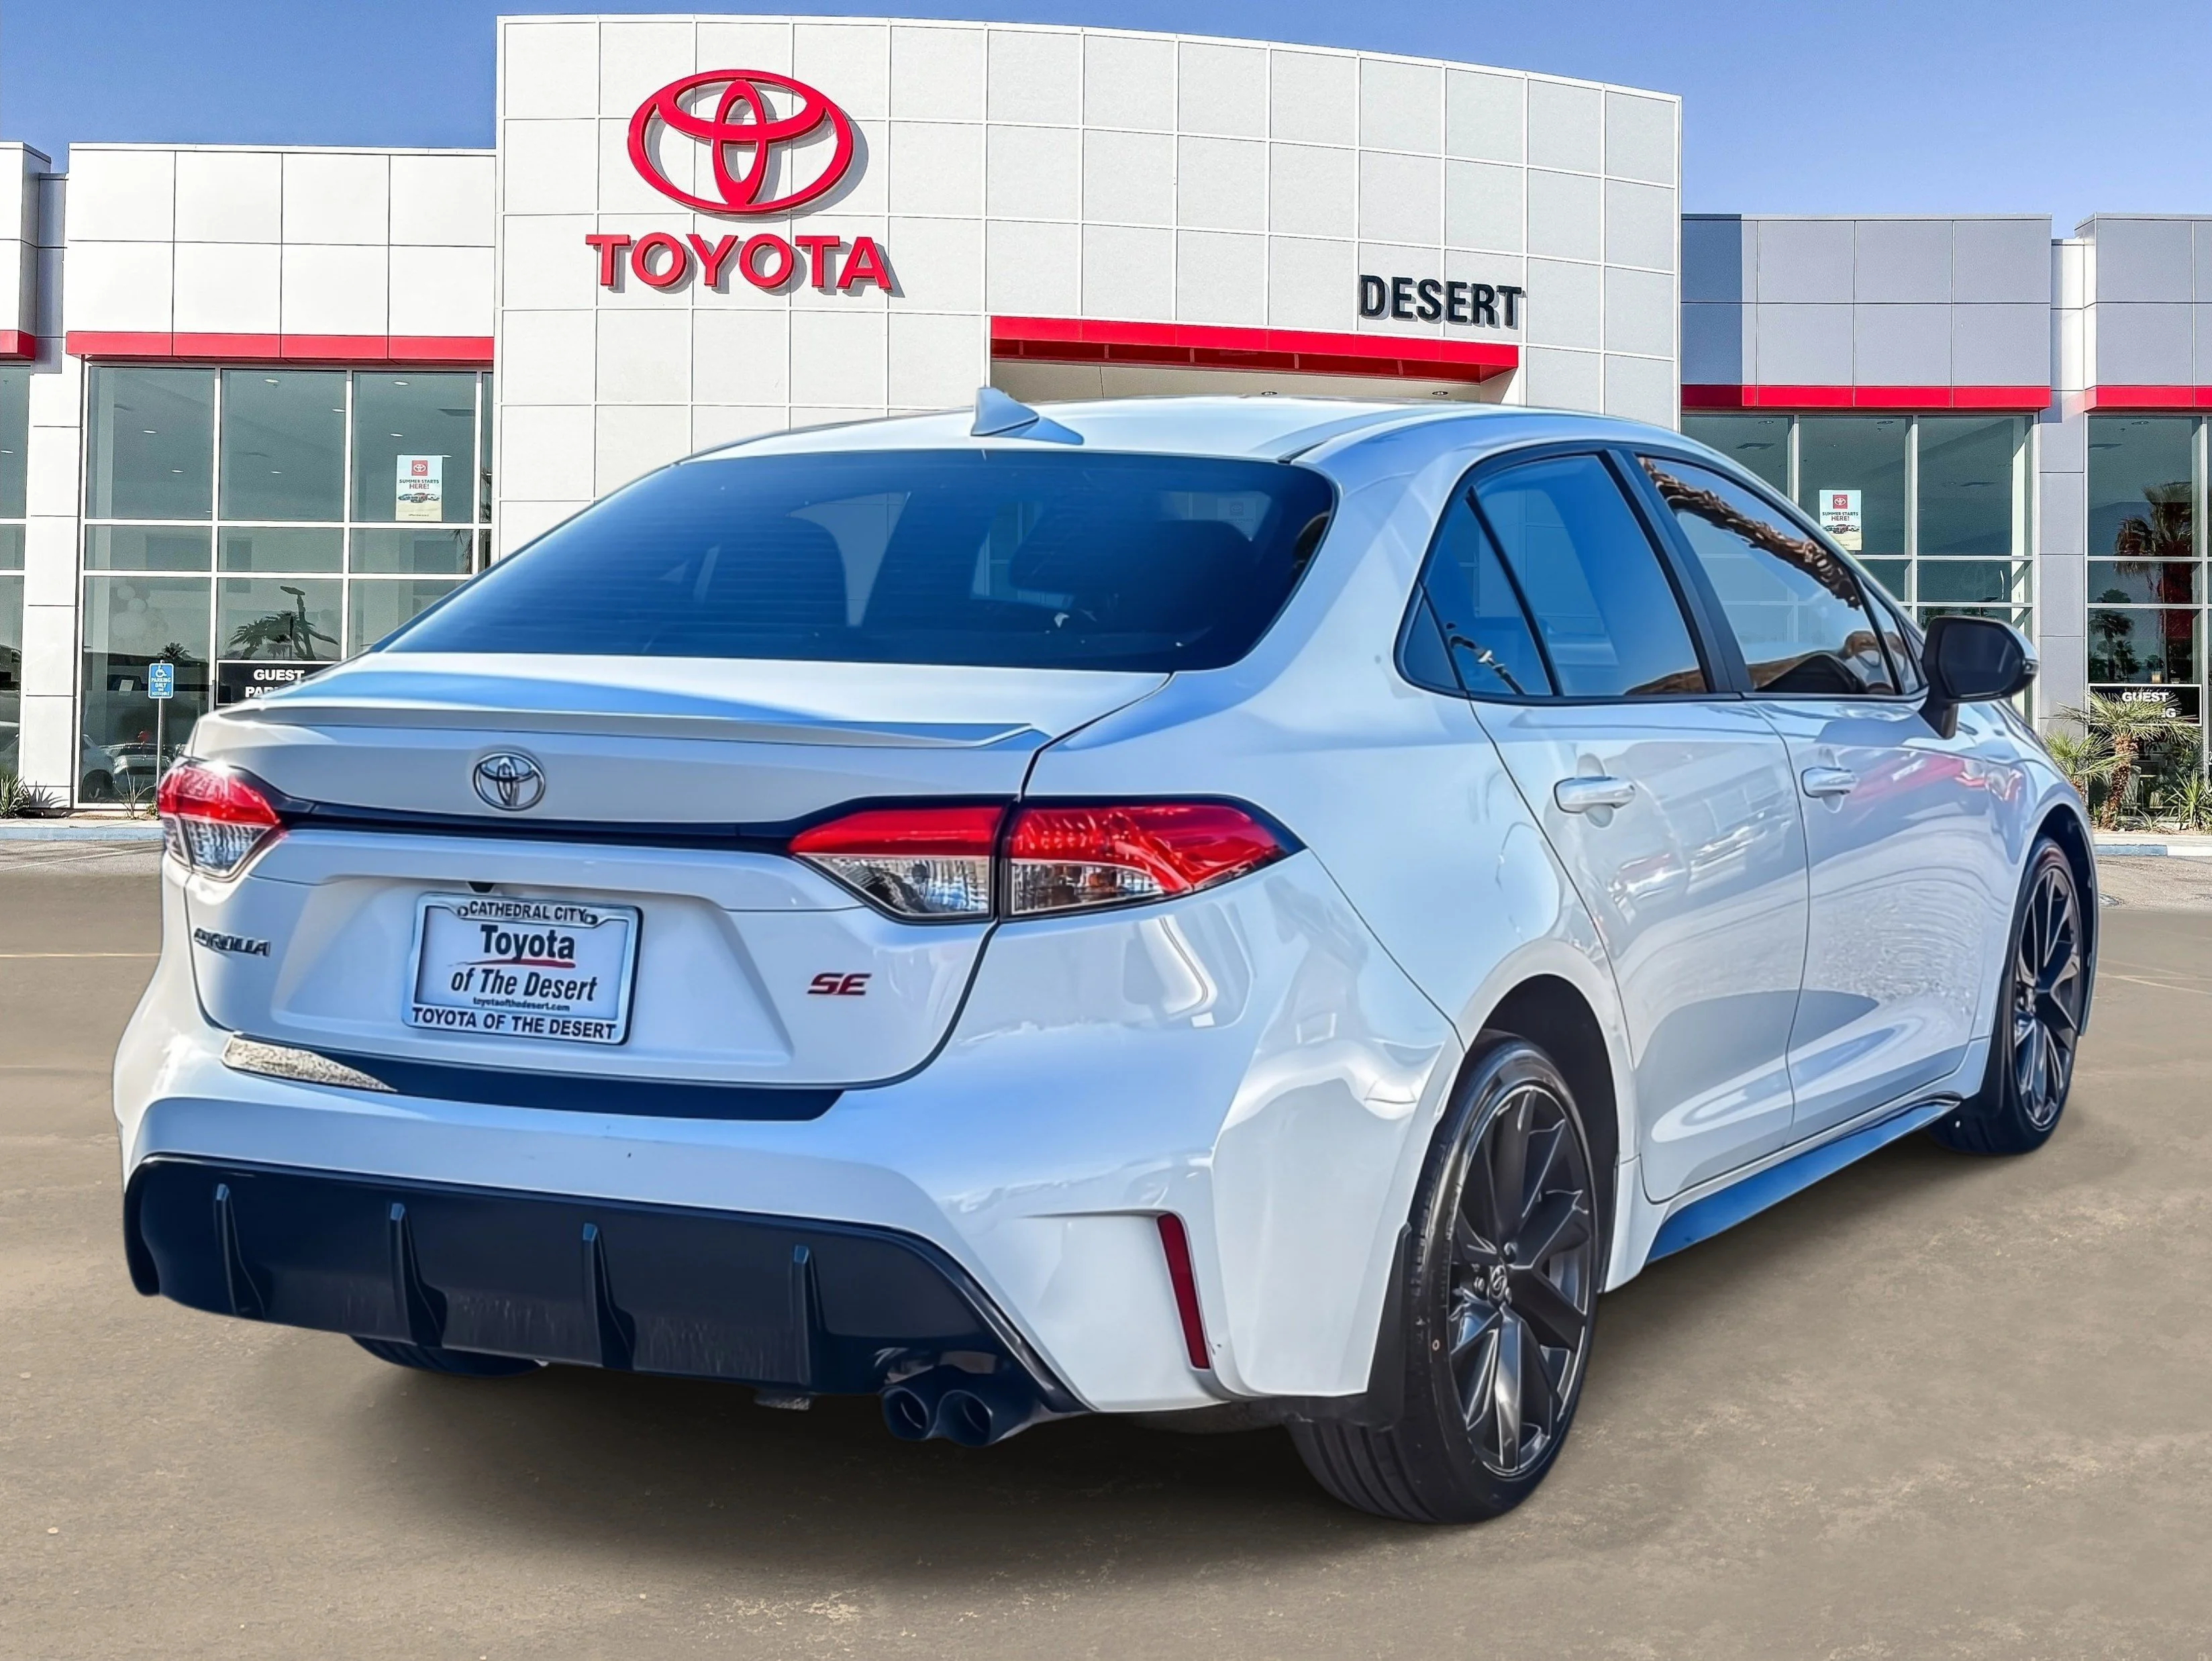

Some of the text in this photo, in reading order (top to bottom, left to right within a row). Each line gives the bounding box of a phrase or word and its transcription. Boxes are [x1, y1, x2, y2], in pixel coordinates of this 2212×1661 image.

[585, 232, 892, 290] TOYOTA
[1359, 274, 1522, 327] DESERT
[253, 669, 305, 681] GUEST
[2121, 691, 2169, 703] GUEST
[470, 901, 586, 922] CATHEDRAL CITY
[480, 923, 576, 962] Toyota
[450, 968, 598, 1001] of The Desert
[807, 972, 872, 996] SE
[412, 1007, 617, 1040] TOYOTA OF THE DESERT
